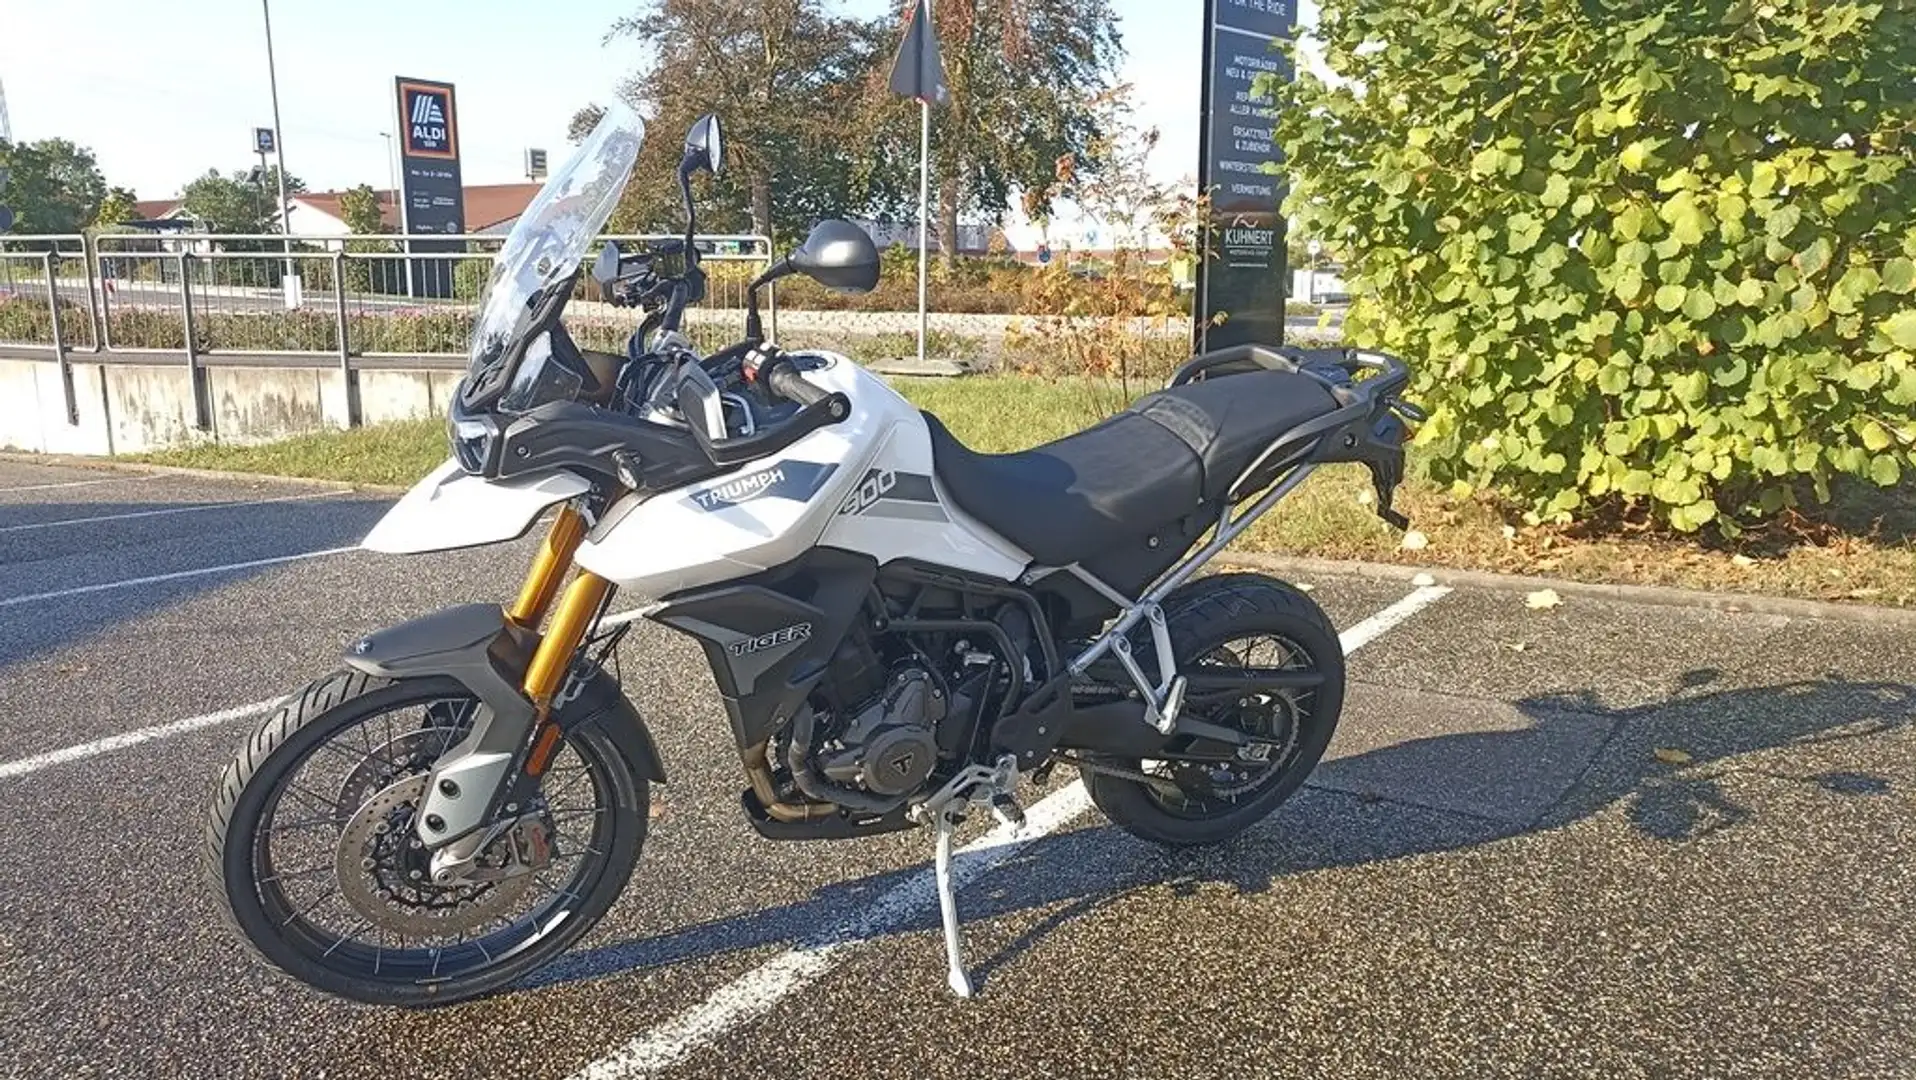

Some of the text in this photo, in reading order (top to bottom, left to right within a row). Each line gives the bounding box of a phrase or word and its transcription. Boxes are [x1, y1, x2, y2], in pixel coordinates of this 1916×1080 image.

[1267, 0, 1285, 16] RIDE
[1225, 67, 1239, 78] NEU
[413, 125, 446, 141] ALDI
[697, 468, 785, 508] TRIUMPH
[842, 470, 896, 517] 900
[729, 622, 813, 657] TIGER
